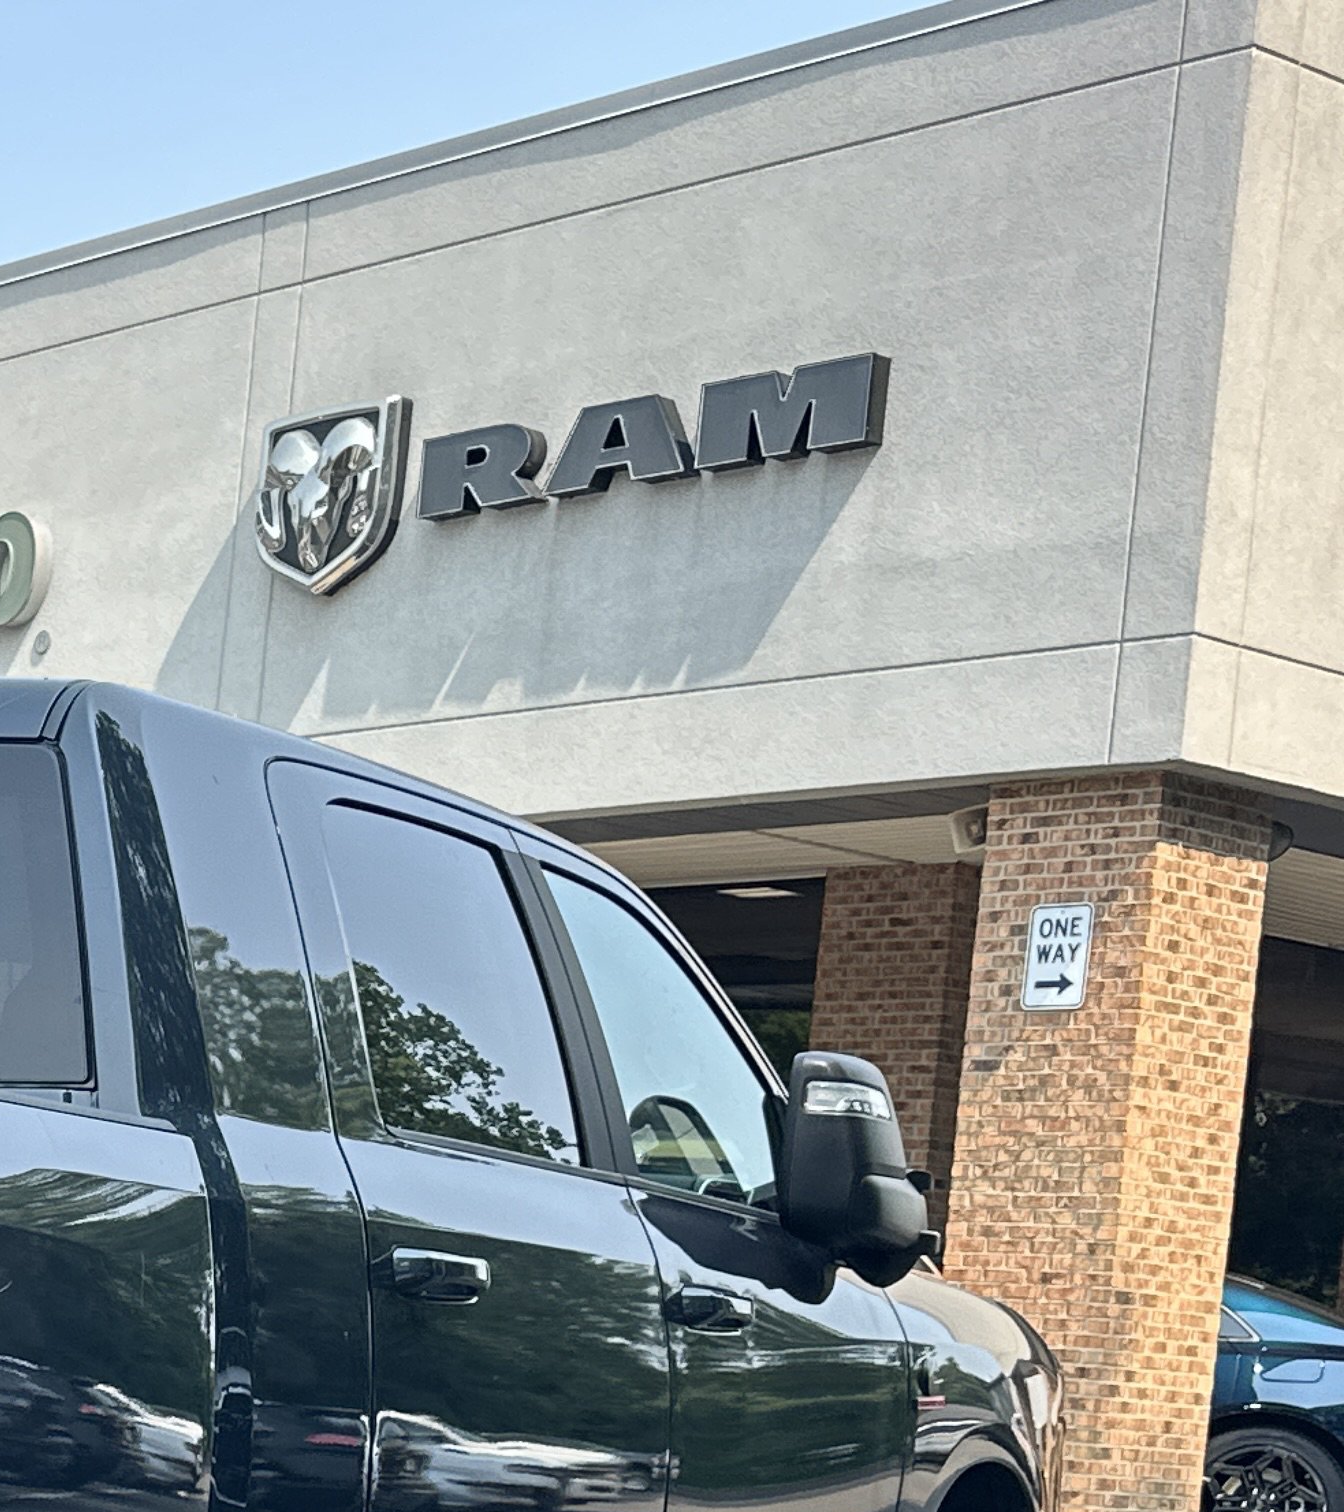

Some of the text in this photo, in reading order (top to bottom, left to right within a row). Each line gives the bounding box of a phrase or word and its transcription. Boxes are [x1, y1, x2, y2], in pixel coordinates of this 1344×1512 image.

[416, 353, 891, 521] RAM
[1039, 916, 1083, 939] ONE
[1036, 942, 1082, 964] WAY
